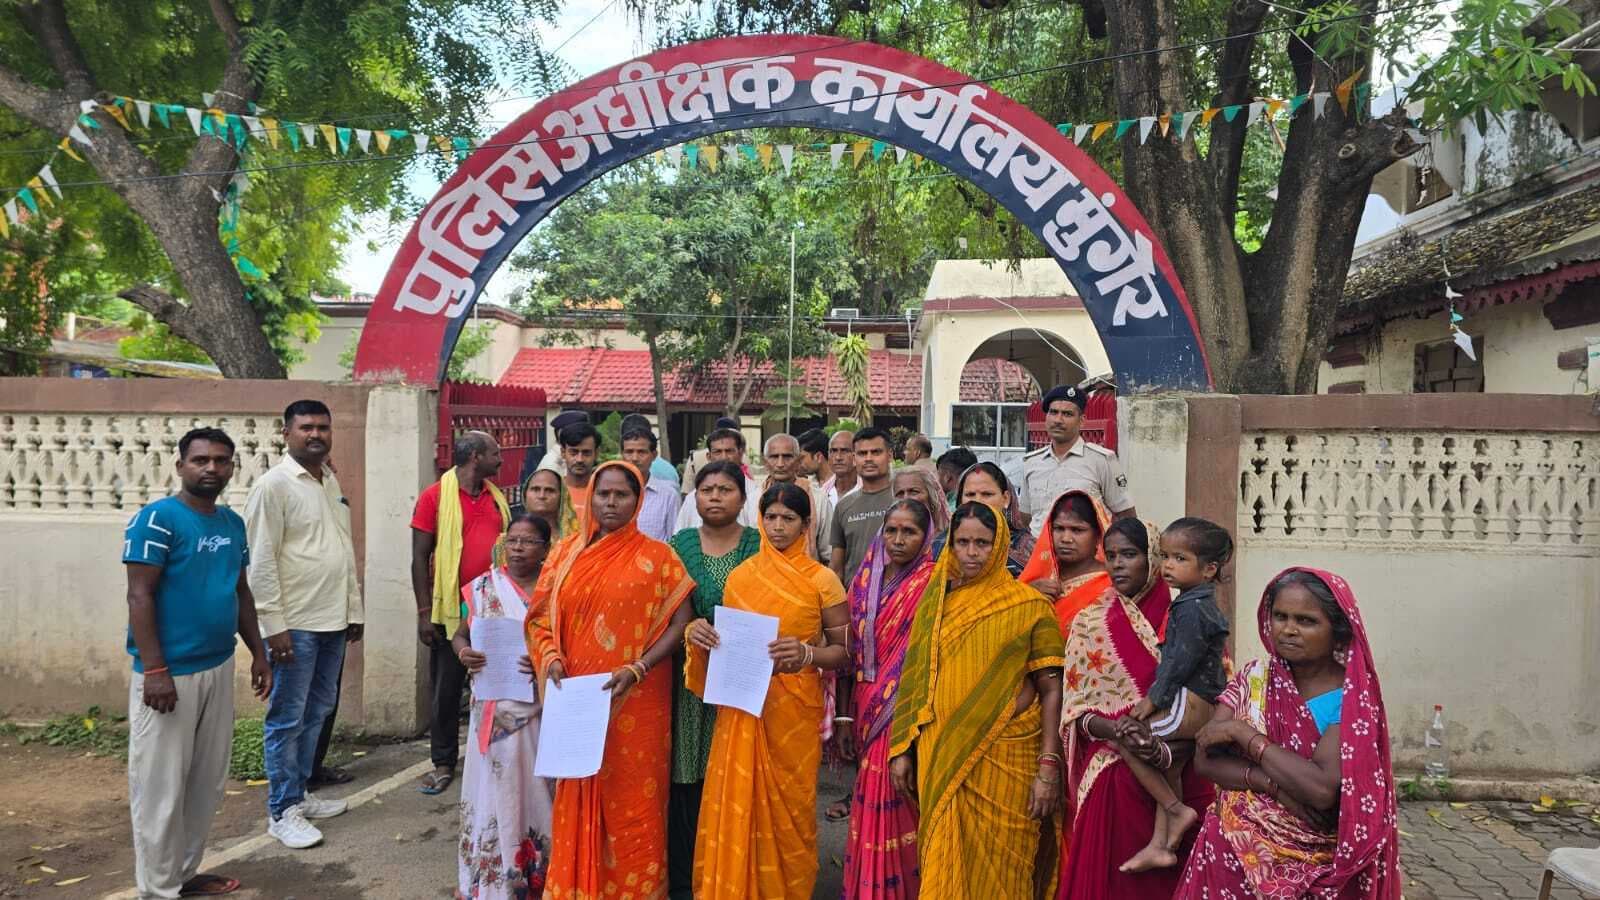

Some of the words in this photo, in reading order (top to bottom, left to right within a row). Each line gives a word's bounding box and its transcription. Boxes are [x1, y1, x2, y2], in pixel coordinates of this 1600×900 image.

[393, 131, 562, 318] पुलिस
[543, 55, 796, 172] अधीक्षक
[811, 57, 1080, 212] कार्यालय
[1043, 187, 1168, 326] मुंगेर
